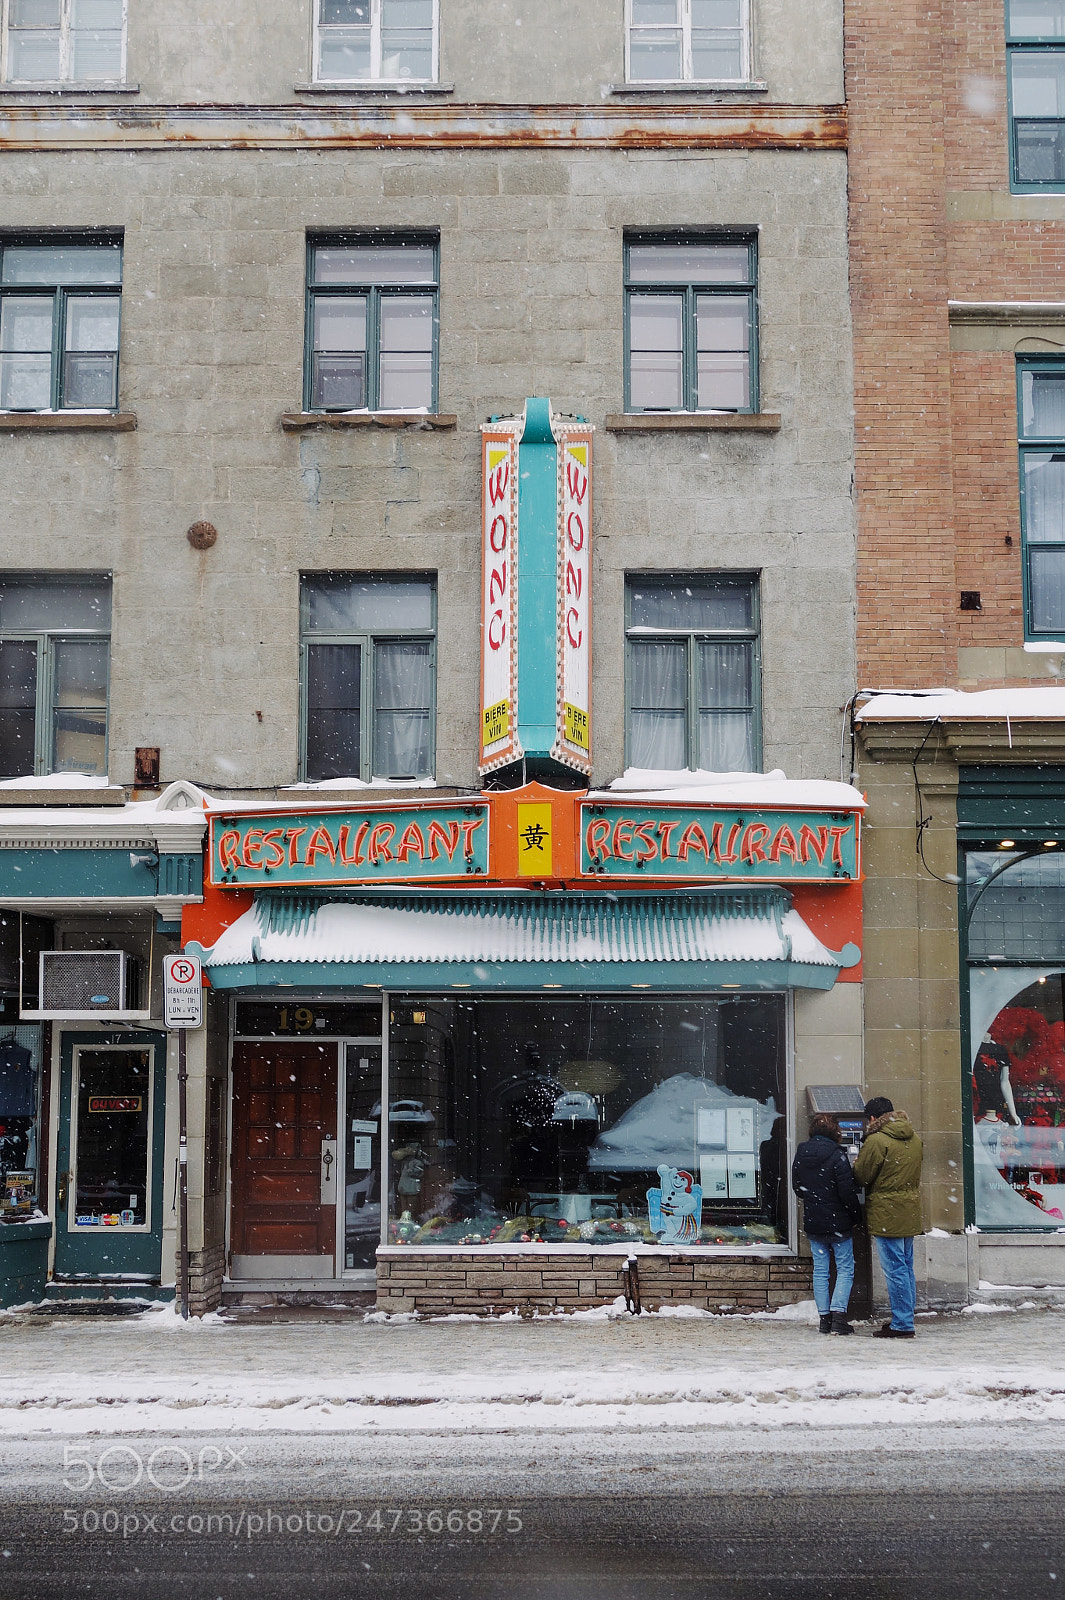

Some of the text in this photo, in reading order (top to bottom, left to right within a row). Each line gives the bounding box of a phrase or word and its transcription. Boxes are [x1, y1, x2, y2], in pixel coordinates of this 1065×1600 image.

[485, 703, 506, 723] BIÈRE
[489, 723, 502, 738] VIN
[571, 726, 583, 742] VIN
[218, 818, 485, 872] RESTAURANT
[586, 816, 852, 866] RESTAURANT
[279, 1008, 313, 1029] 19
[112, 1034, 121, 1044] 17
[92, 1100, 138, 1110] OUVERT
